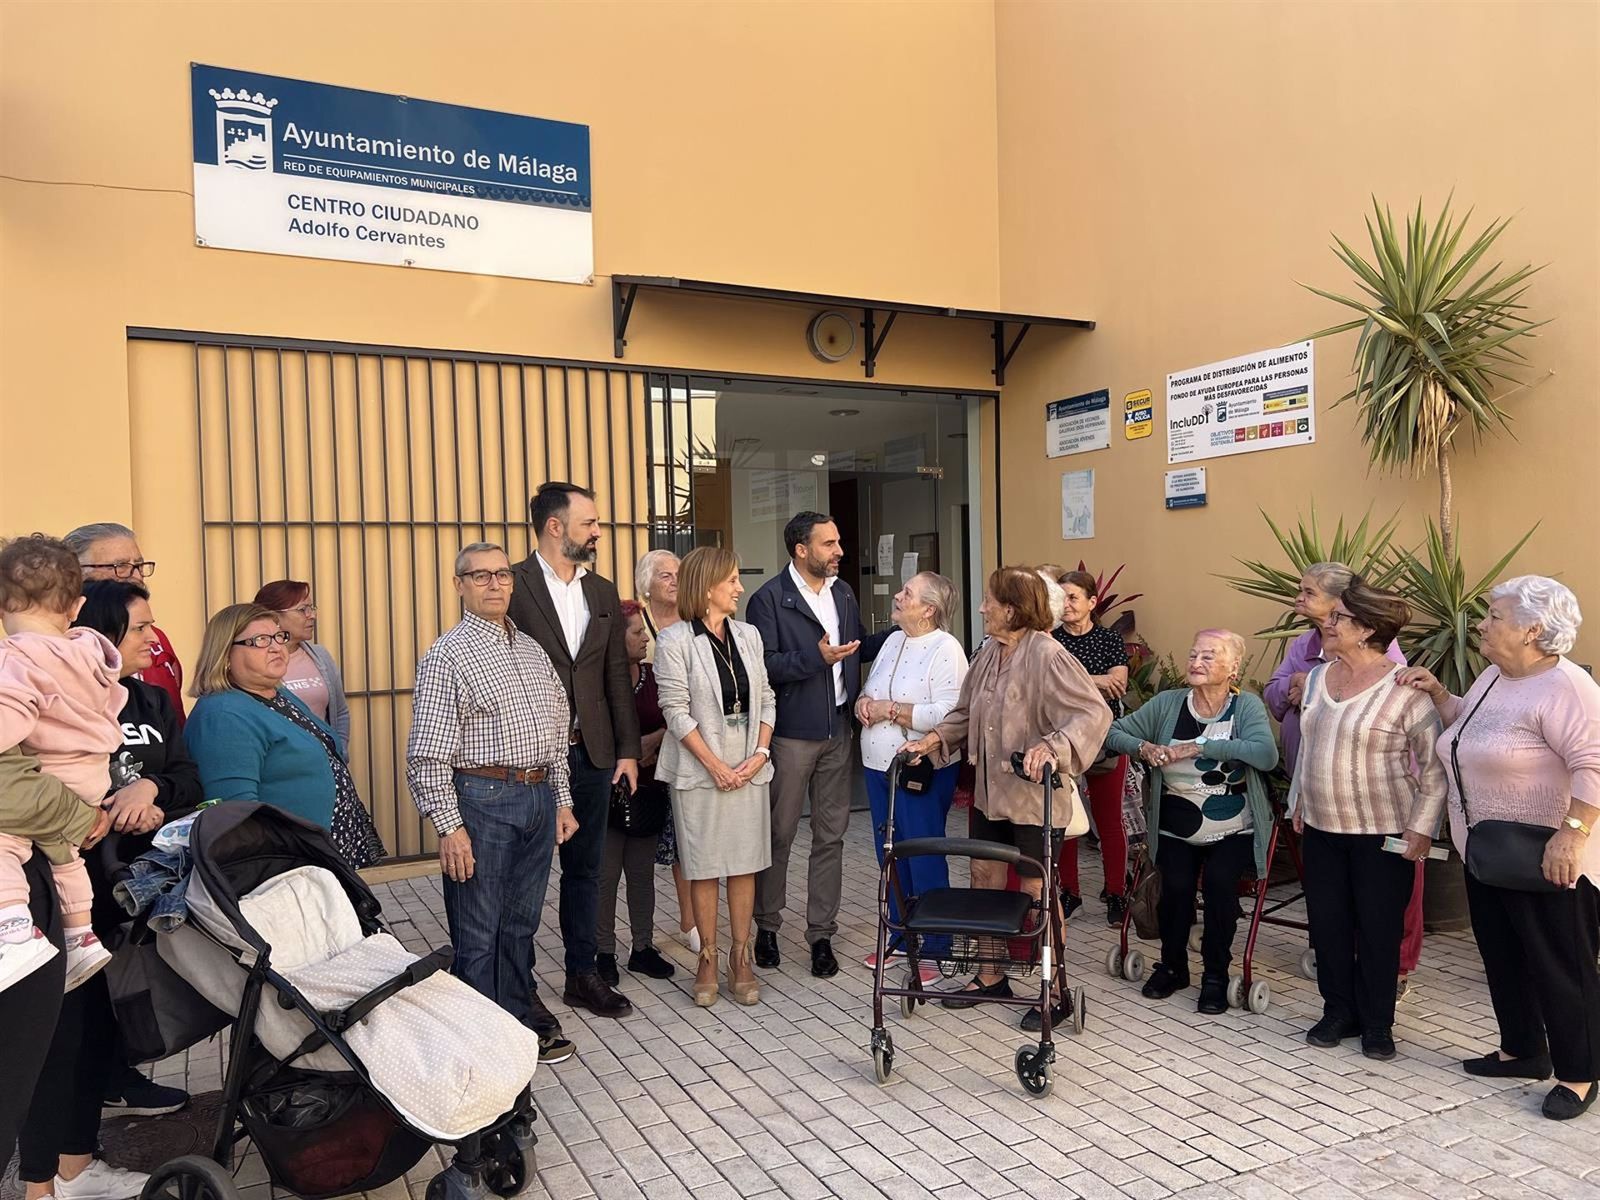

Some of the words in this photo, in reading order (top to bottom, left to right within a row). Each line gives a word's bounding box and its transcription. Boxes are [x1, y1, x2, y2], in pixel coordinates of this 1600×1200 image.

[283, 122, 455, 166] Ayuntamiento
[463, 149, 491, 170] de
[498, 153, 578, 184] Málaga
[283, 160, 306, 172] RED
[308, 164, 323, 174] DE
[326, 166, 408, 186] EQUIPAMIENTOS
[410, 178, 475, 194] MUNICIPALES
[288, 194, 366, 217] CENTRO
[371, 204, 479, 230] CIUDADANO
[288, 217, 350, 239] Adolfo
[355, 225, 445, 249] Cervantes
[1170, 374, 1202, 388] PROGRAMA
[1203, 372, 1211, 381] DE
[1212, 362, 1256, 379] DISTRIBUCIÓN
[1258, 360, 1267, 369] DE
[1268, 351, 1308, 367] ALIMENTOS
[1170, 391, 1188, 401] FONDO
[1190, 389, 1196, 397] DE
[1197, 386, 1216, 395] AYUDA
[1217, 380, 1243, 391] EUROPEA
[1244, 377, 1260, 386] PARA
[1261, 374, 1273, 383] LAS
[1274, 367, 1308, 380] PERSONAS
[1217, 383, 1268, 399] DESFAVORECIDAS
